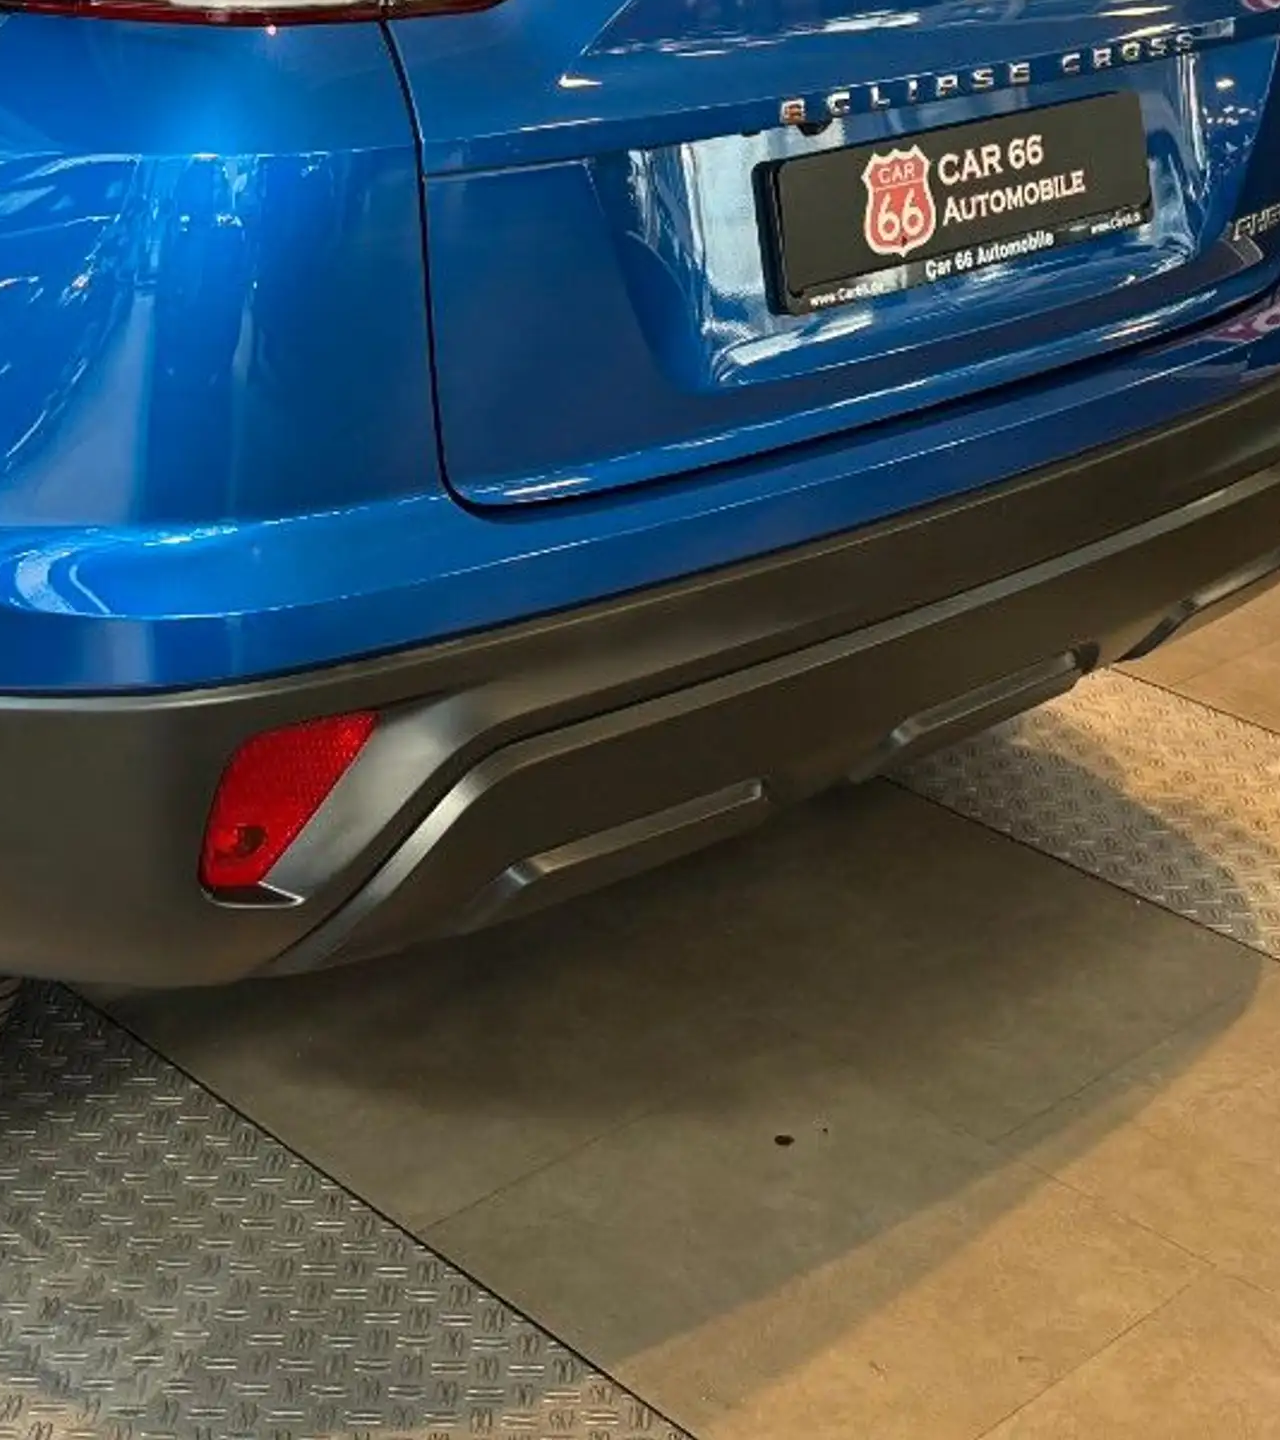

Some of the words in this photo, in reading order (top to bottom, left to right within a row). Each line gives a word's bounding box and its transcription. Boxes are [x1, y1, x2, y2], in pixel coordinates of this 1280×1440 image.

[780, 61, 1030, 125] ECLIPSE
[1062, 32, 1195, 75] CROSS
[877, 161, 916, 184] CAR
[937, 142, 1004, 186] CAR
[1007, 134, 1045, 171] 66
[876, 187, 925, 241] 66
[941, 168, 1087, 227] AUTOMOBILE
[925, 258, 953, 281] Car
[954, 249, 974, 271] 66
[976, 230, 1055, 266] Automobile
